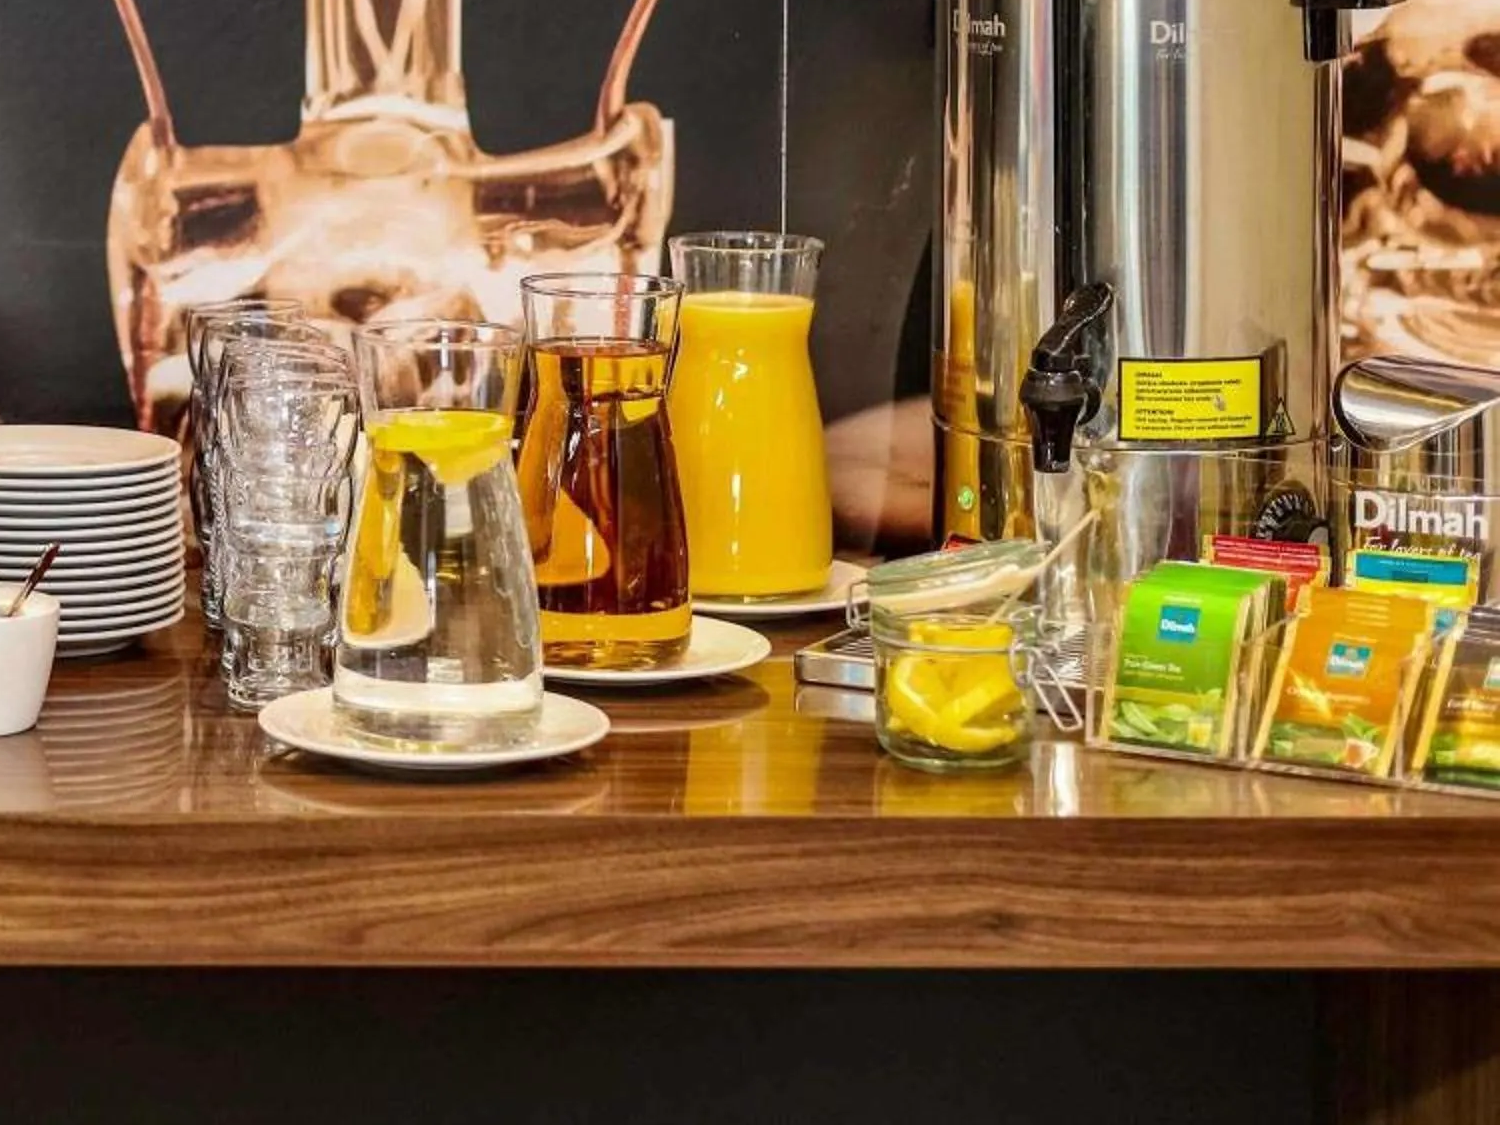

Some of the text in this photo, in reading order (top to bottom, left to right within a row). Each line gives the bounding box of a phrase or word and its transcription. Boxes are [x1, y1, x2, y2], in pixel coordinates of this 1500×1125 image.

[953, 9, 1005, 37] Dlmah
[1355, 490, 1489, 540] Dilmah
[1160, 618, 1196, 634] Dilmah
